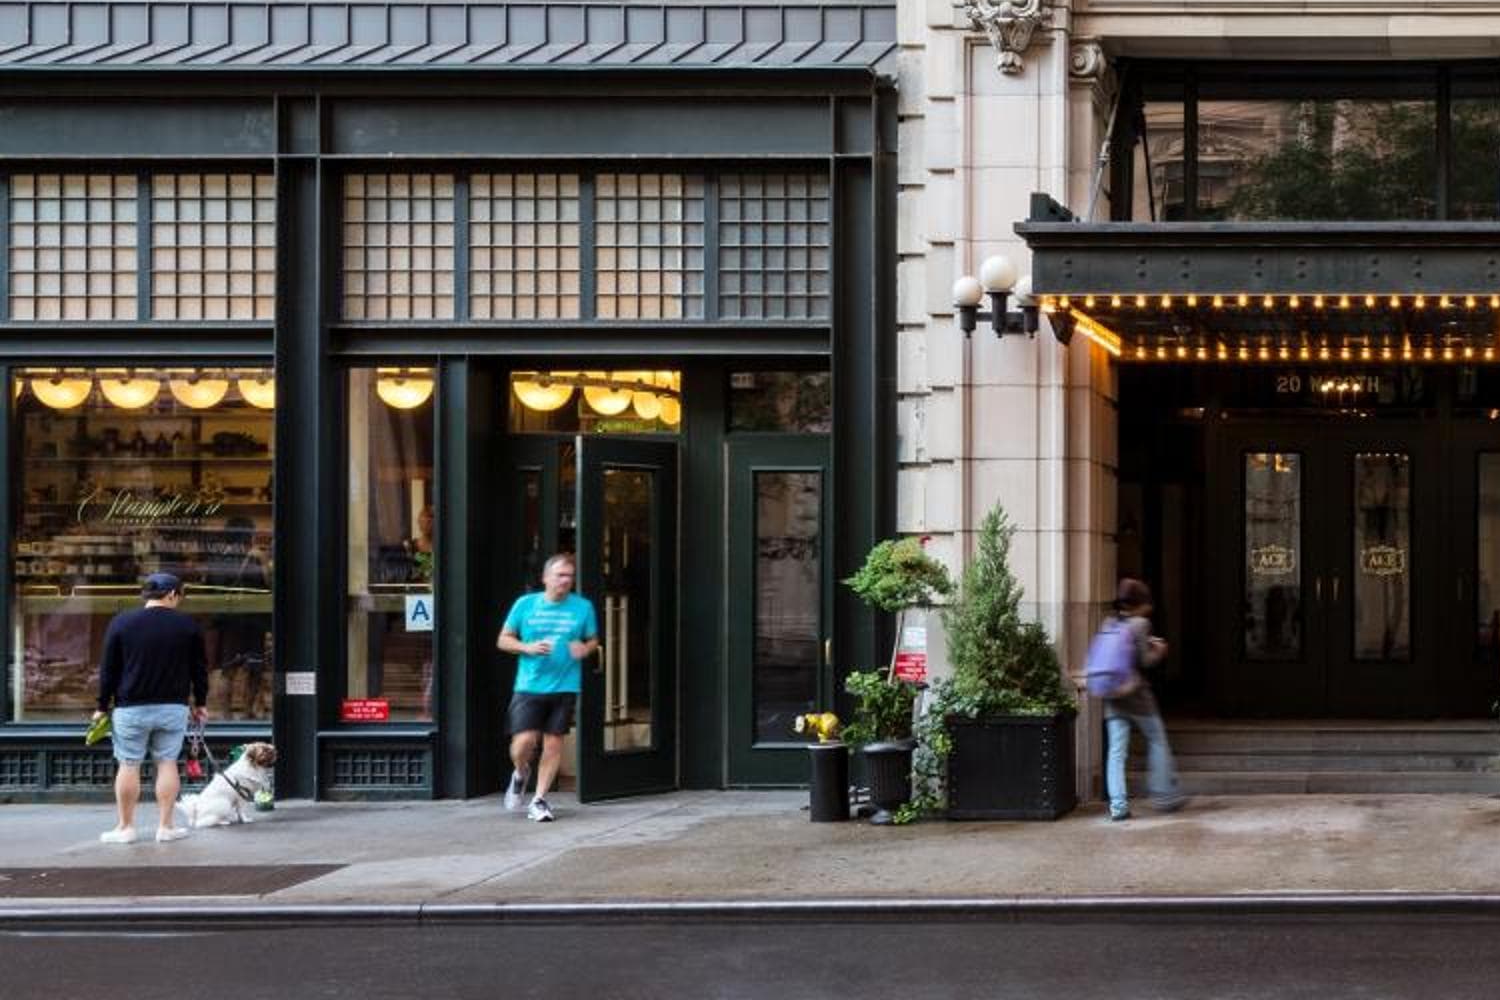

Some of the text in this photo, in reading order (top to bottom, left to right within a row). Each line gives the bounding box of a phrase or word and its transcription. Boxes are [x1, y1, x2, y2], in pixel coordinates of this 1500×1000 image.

[1276, 376, 1301, 393] 20
[1259, 552, 1287, 567] ACE
[411, 599, 430, 621] A
